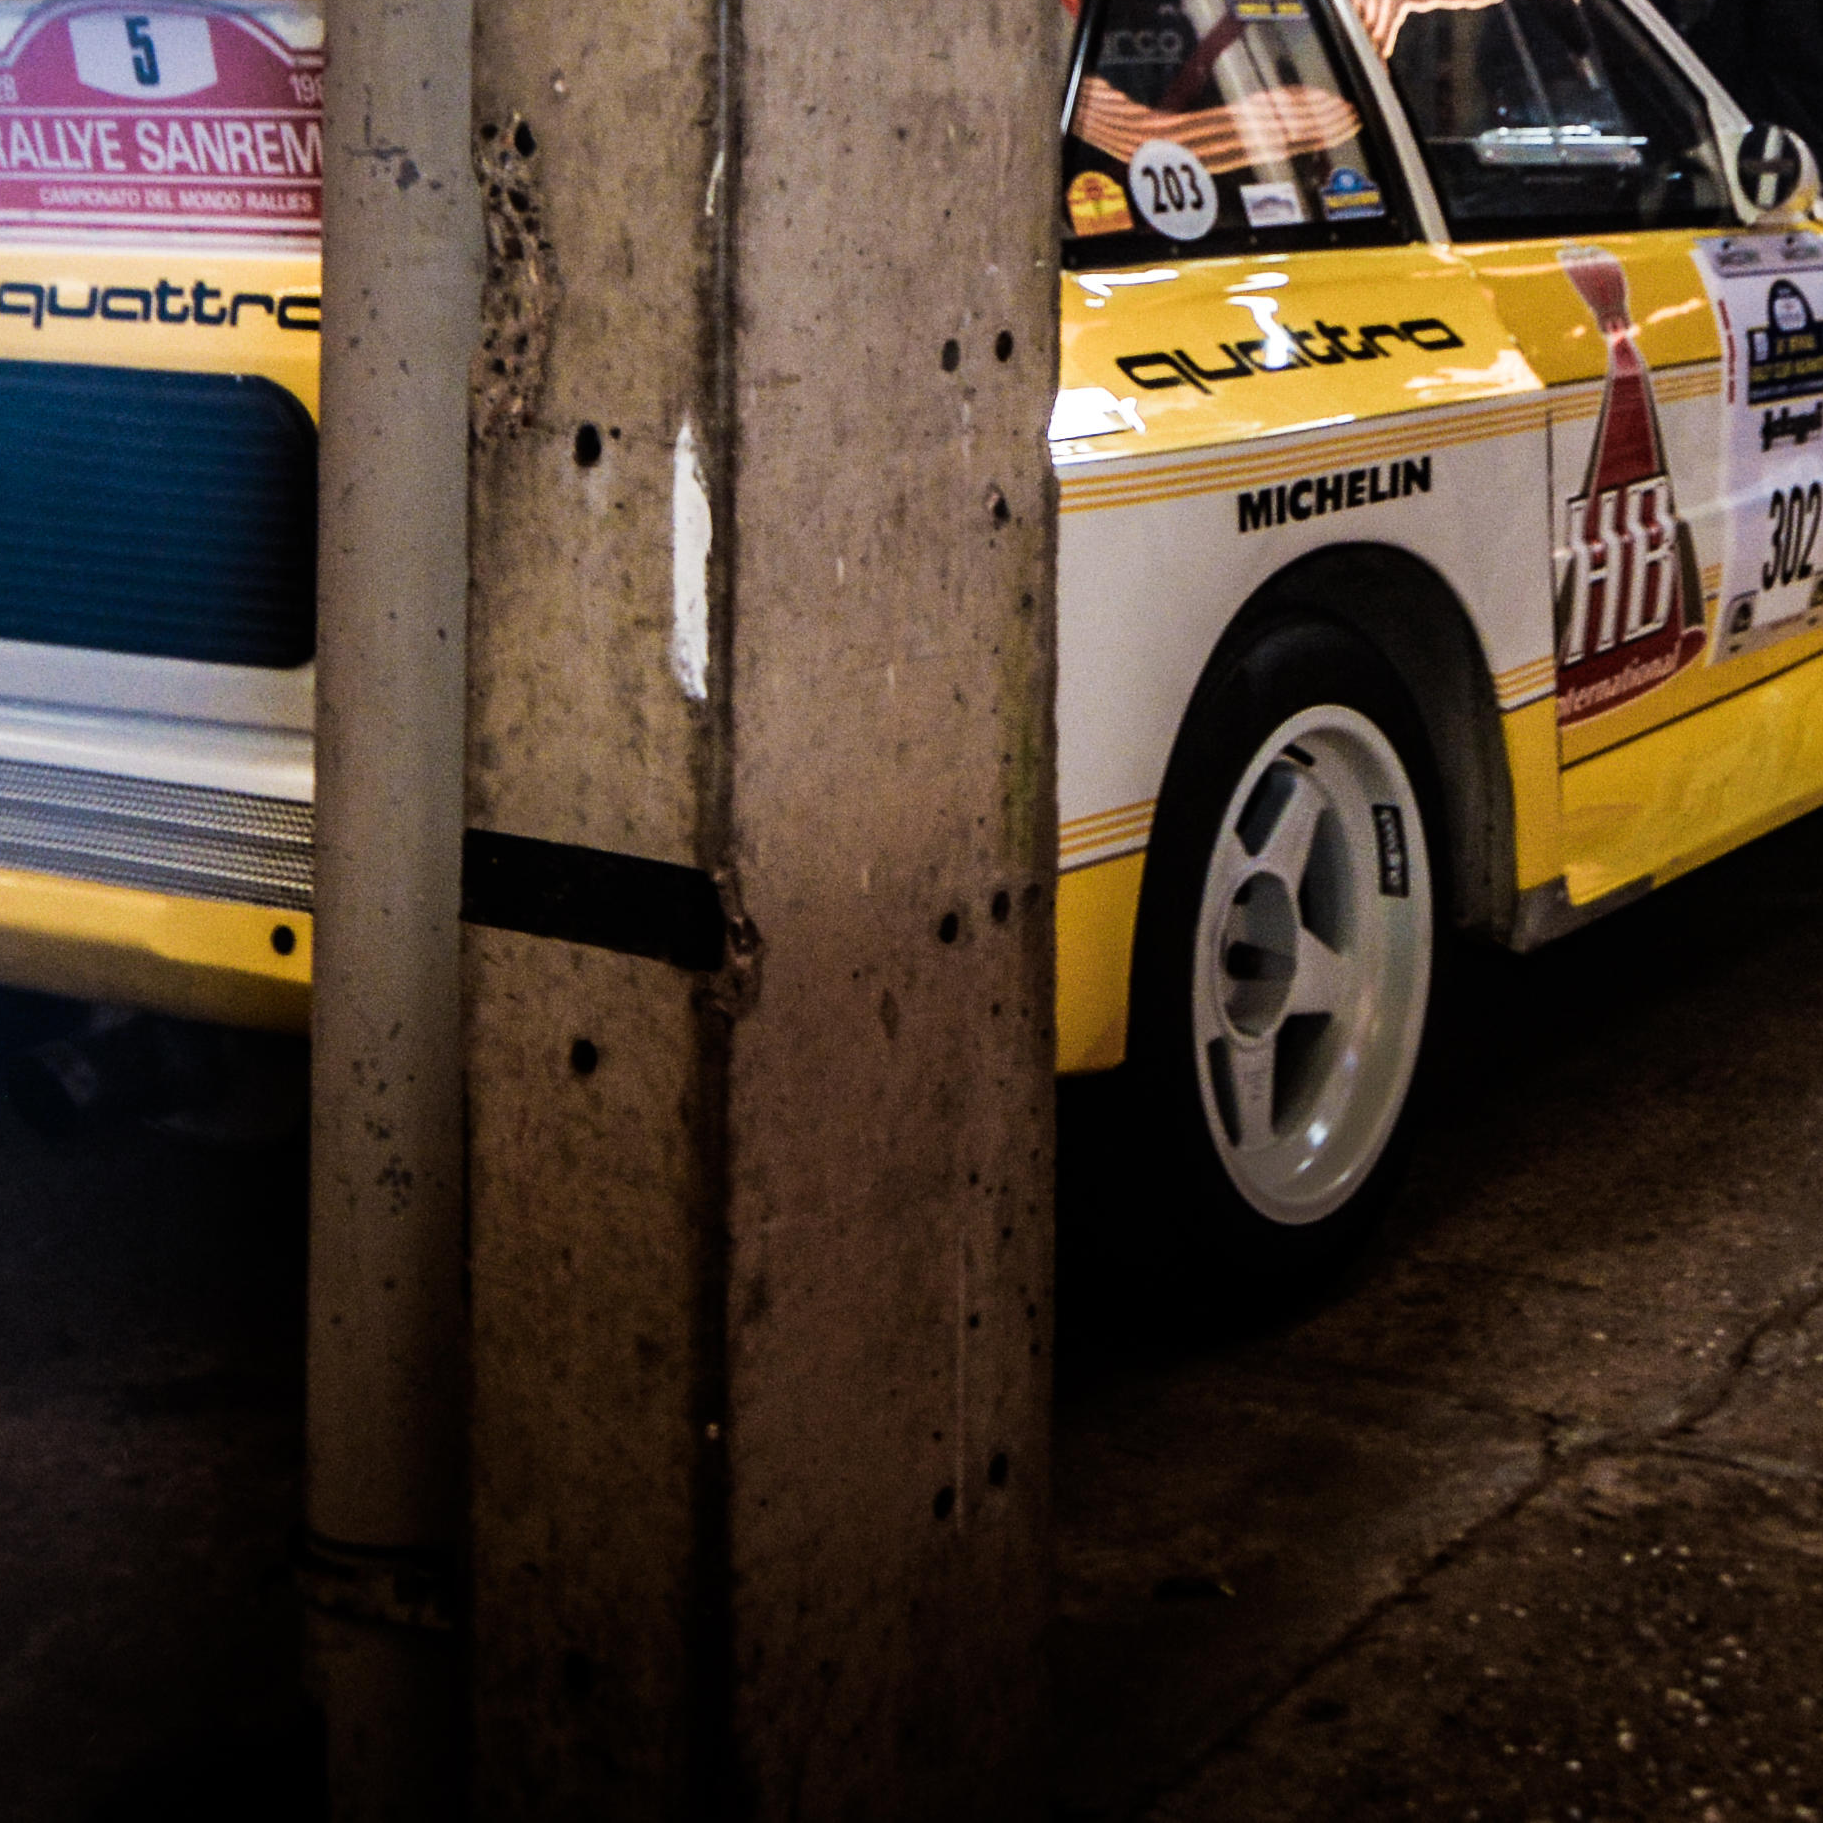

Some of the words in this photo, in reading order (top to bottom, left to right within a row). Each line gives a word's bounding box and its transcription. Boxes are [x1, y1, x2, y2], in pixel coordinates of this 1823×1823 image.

[124, 15, 161, 87] 5
[1141, 162, 1205, 215] 203
[1115, 317, 1466, 394] quattro
[1237, 456, 1432, 533] MICHELIN
[1561, 475, 1677, 665] HB
[1762, 480, 1823, 591] 302
